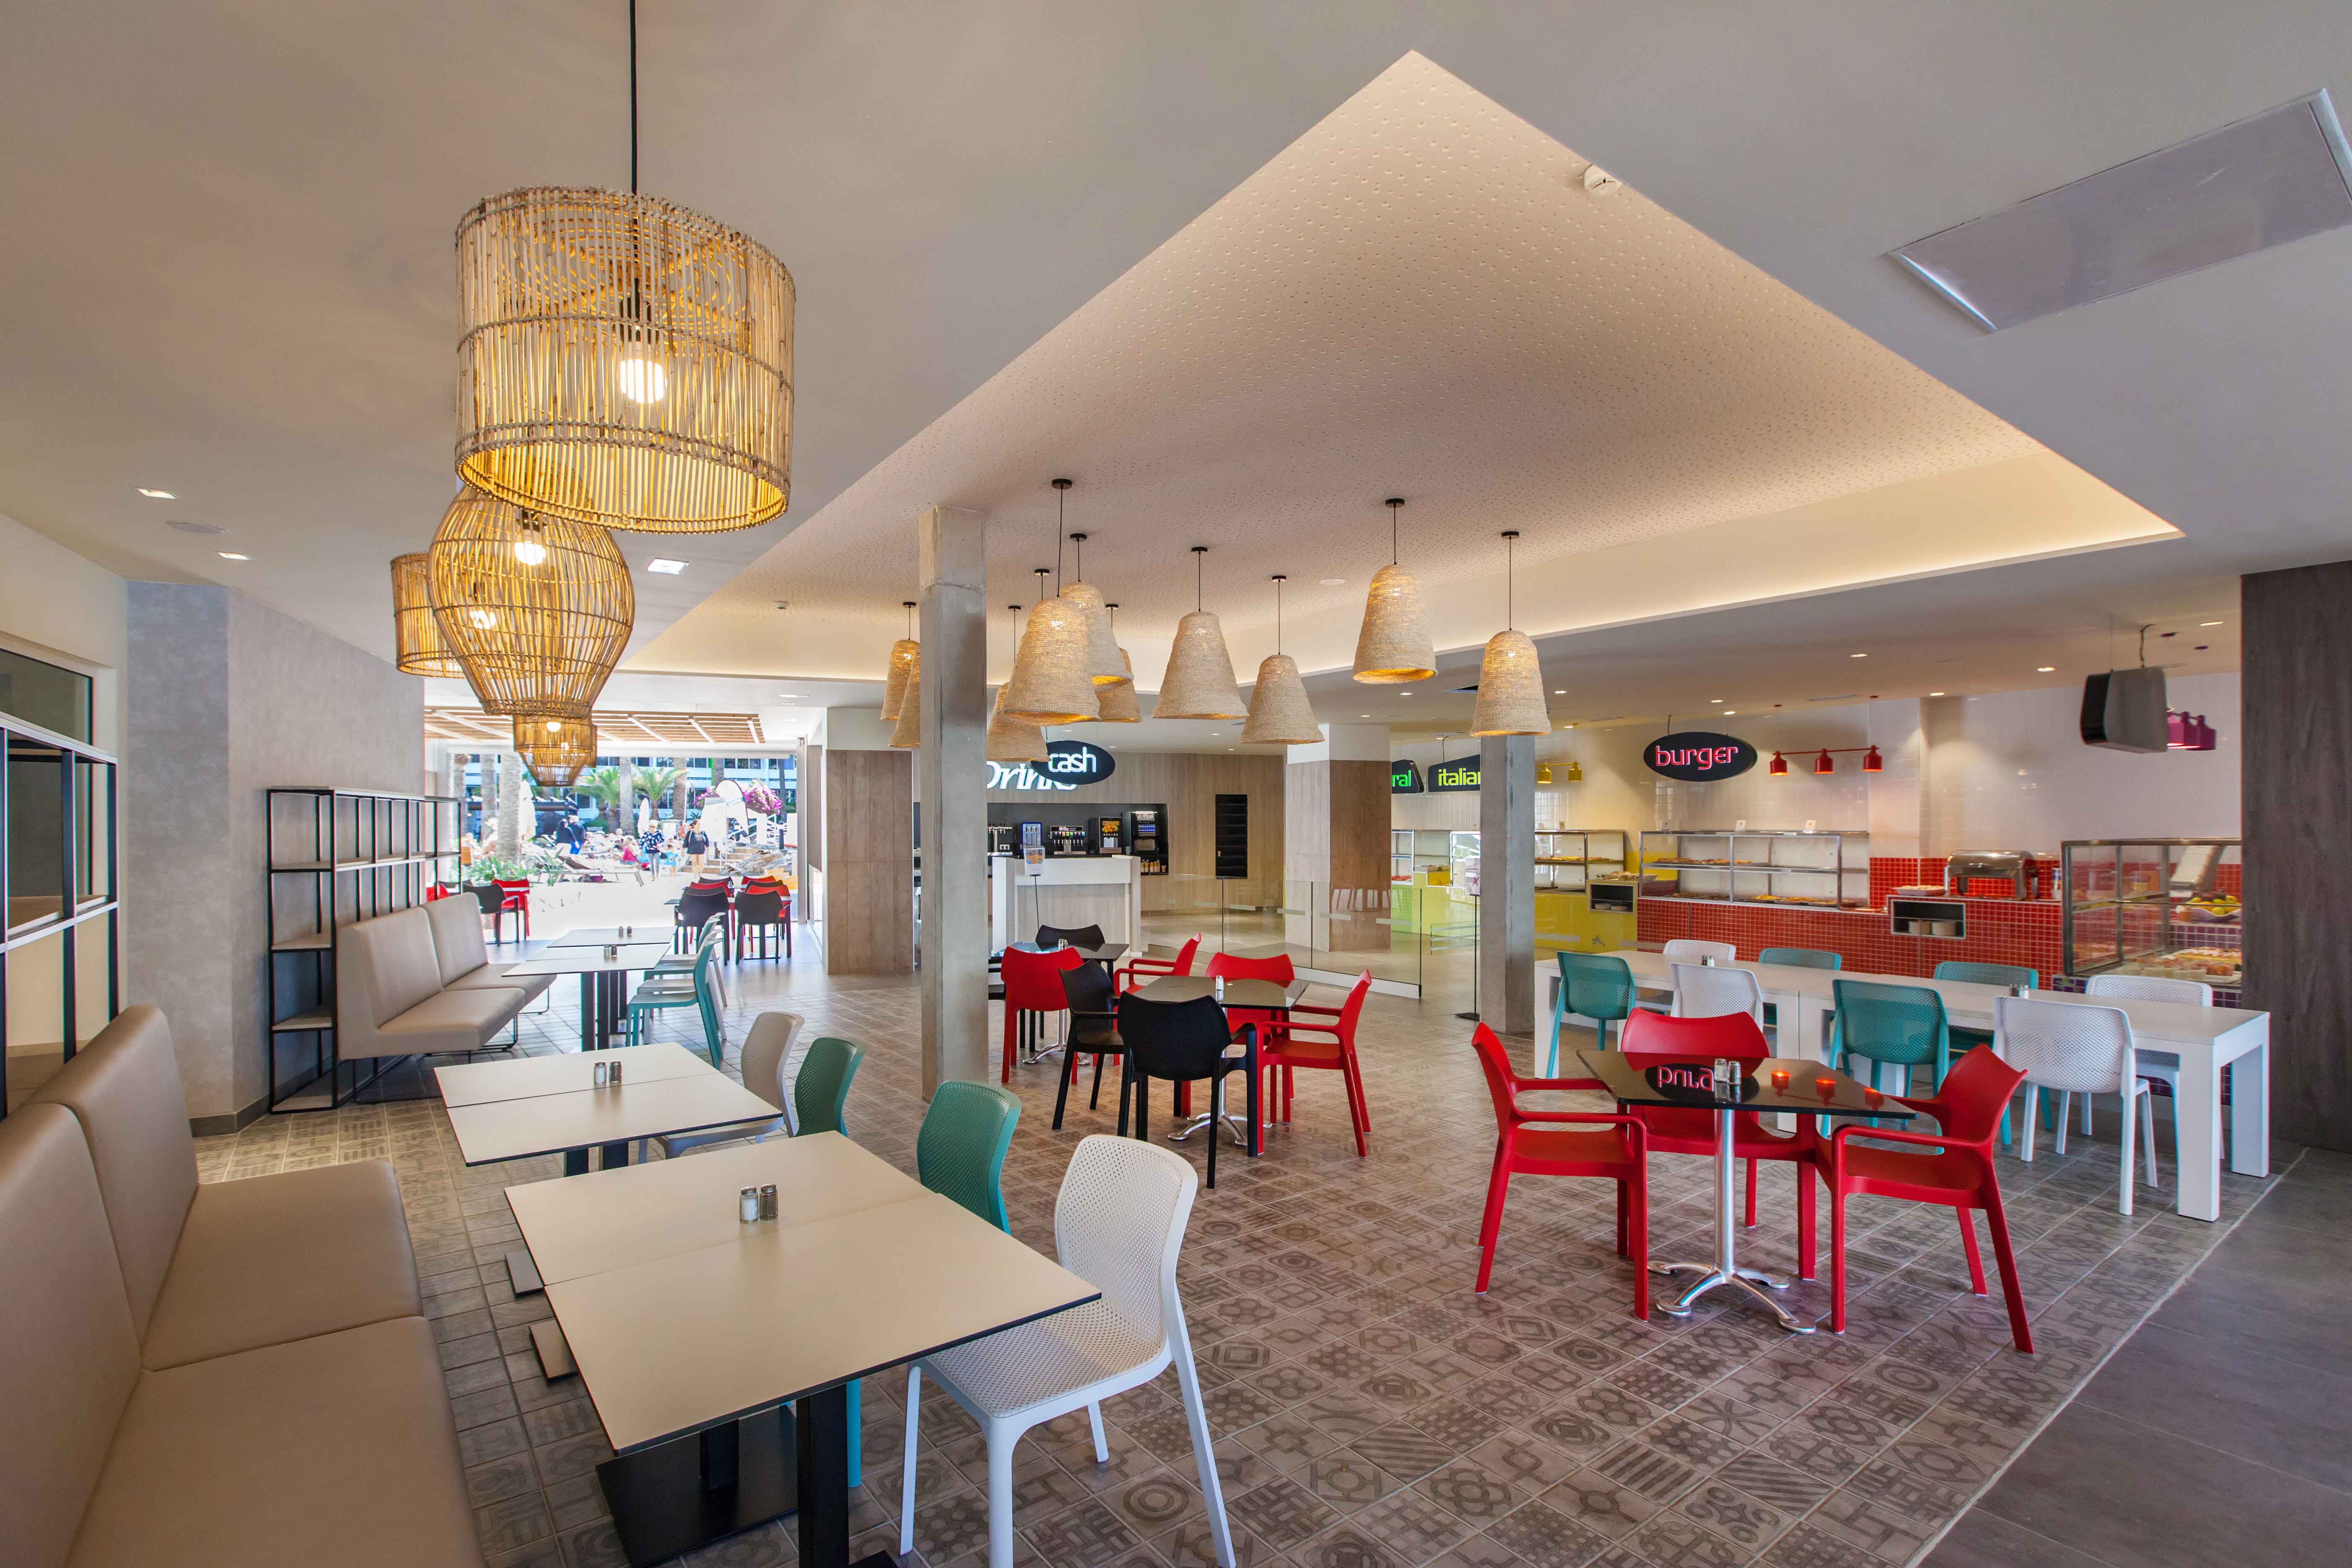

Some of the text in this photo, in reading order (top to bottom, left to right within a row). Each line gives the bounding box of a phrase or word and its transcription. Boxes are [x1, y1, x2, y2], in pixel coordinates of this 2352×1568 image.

[1048, 746, 1097, 773] cash
[1655, 745, 1738, 770] burger
[1392, 770, 1412, 787] ral
